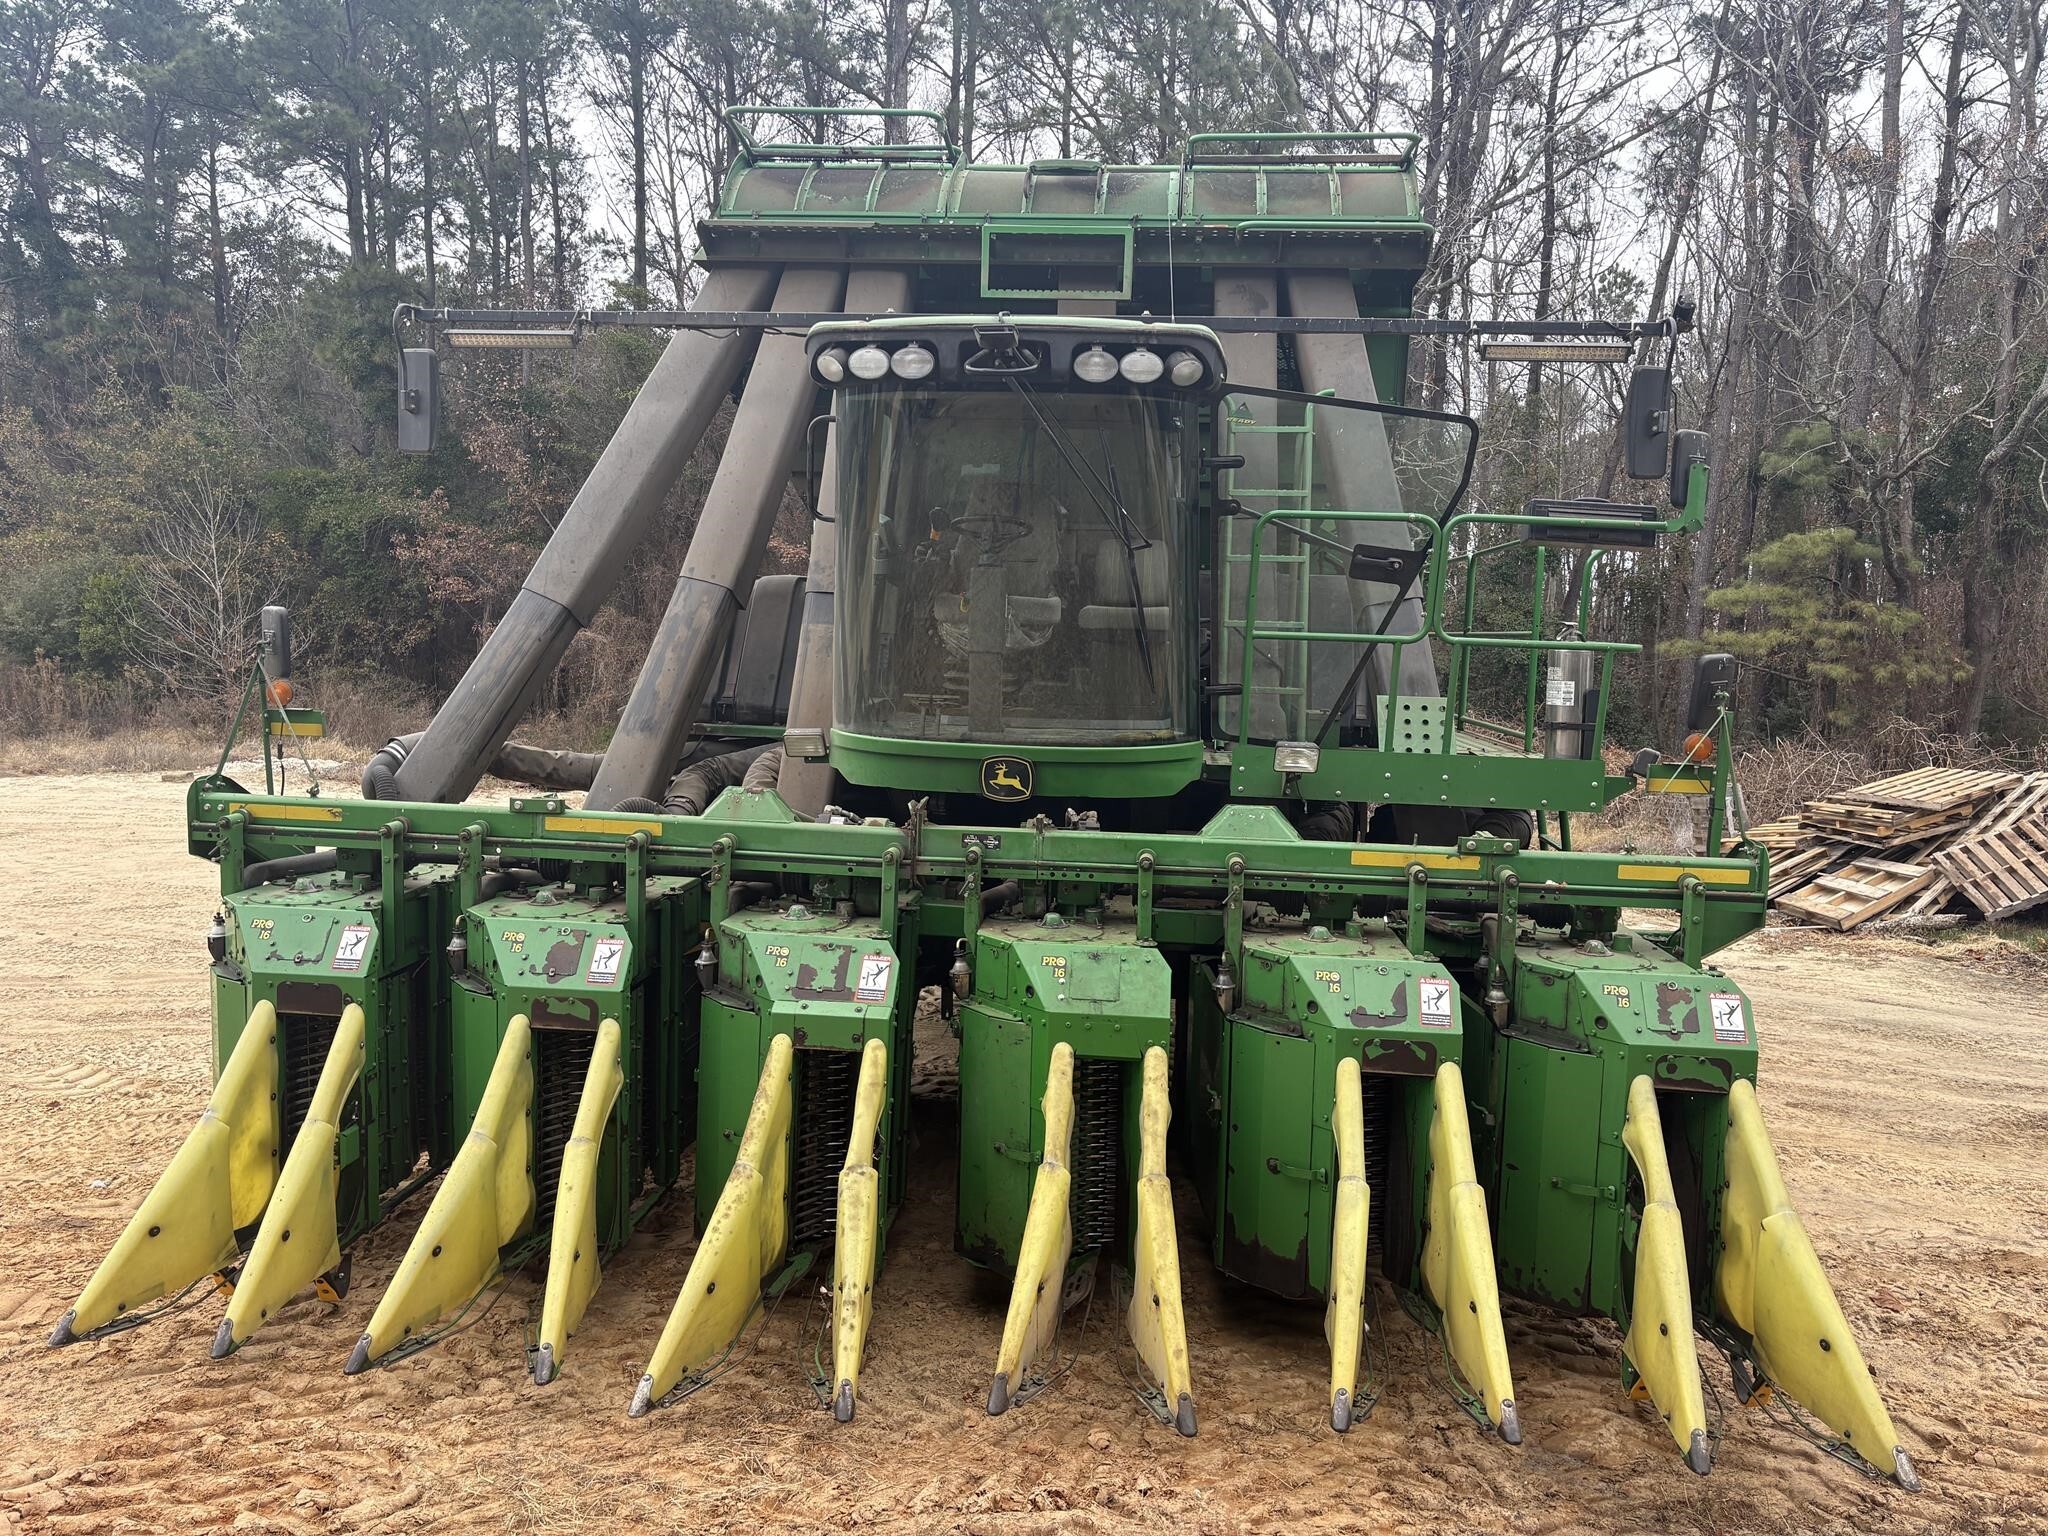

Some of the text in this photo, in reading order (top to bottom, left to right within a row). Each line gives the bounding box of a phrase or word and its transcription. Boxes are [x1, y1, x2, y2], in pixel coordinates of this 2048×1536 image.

[251, 918, 275, 929] PRO
[259, 930, 271, 940] 16
[501, 931, 526, 942] PRO
[510, 943, 523, 953] 16
[766, 945, 790, 957] PRO
[775, 957, 788, 968] 16
[1041, 956, 1067, 967] PRO
[1053, 968, 1066, 978] 16
[1315, 970, 1341, 982] PRO
[1328, 982, 1341, 993] 16
[1603, 985, 1629, 996] PRO
[1617, 997, 1630, 1008] 16
